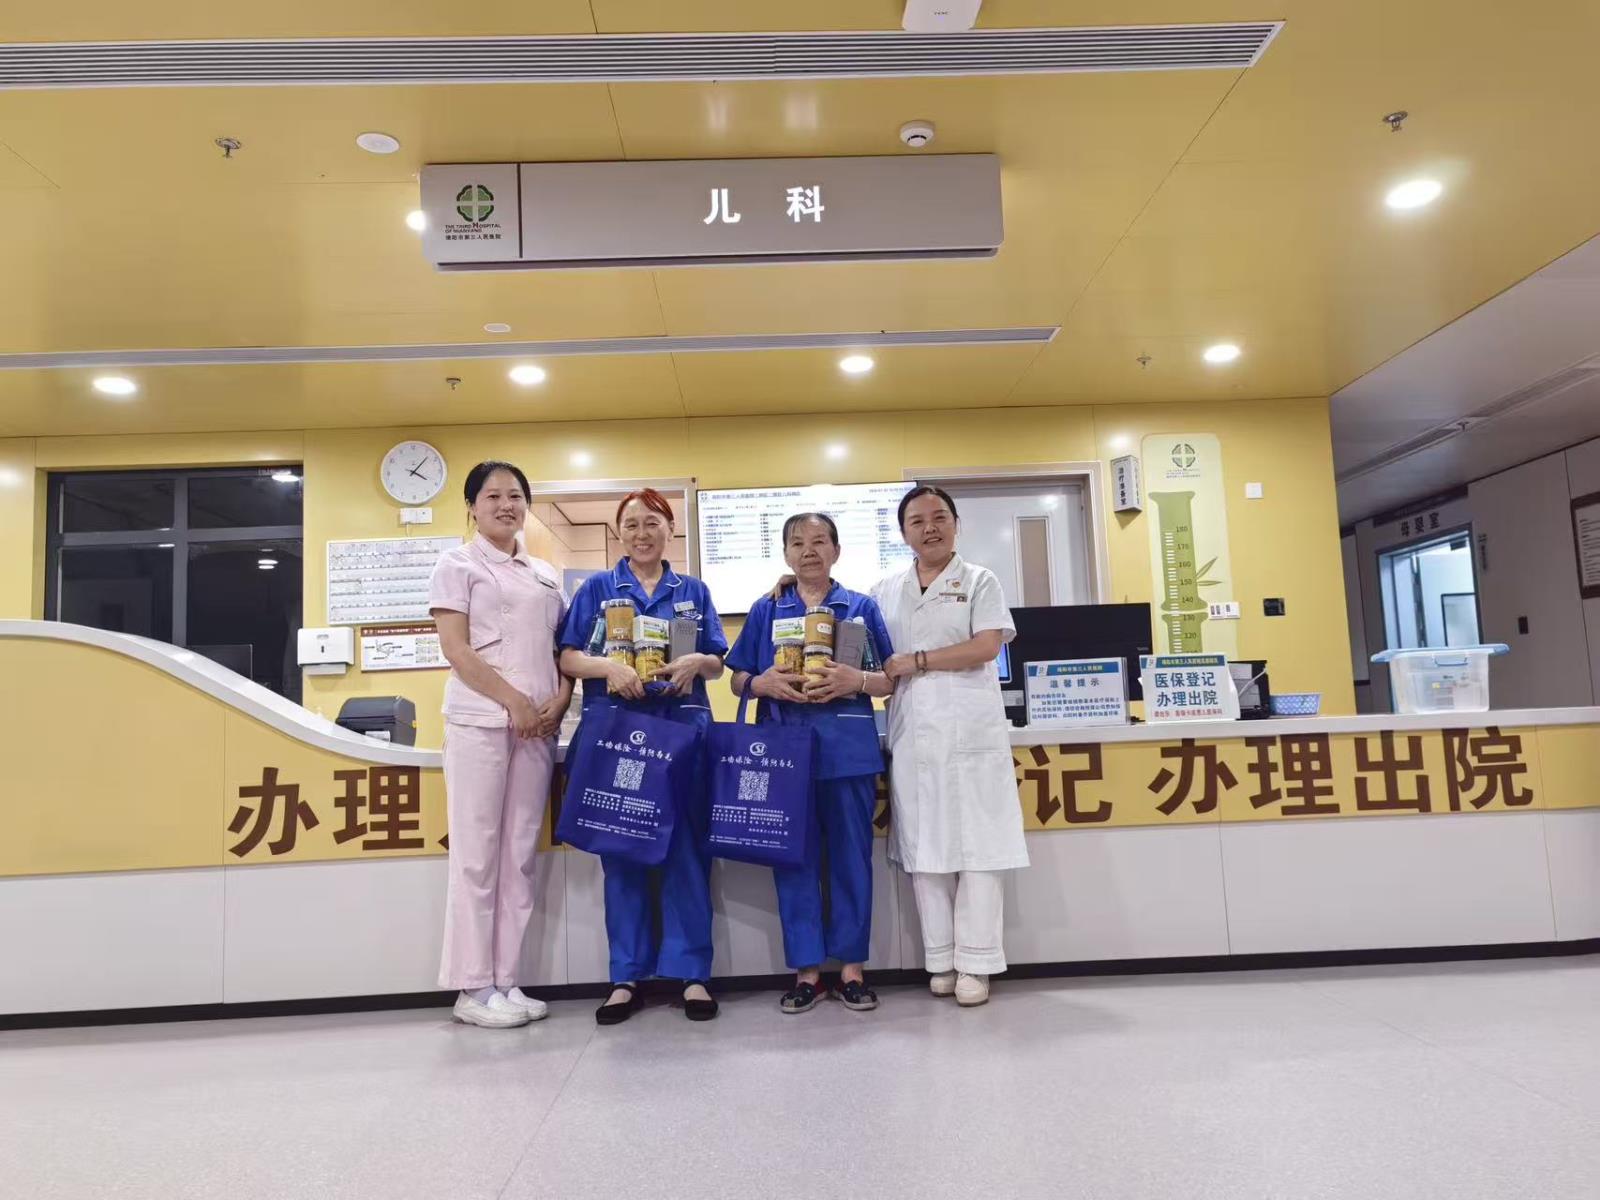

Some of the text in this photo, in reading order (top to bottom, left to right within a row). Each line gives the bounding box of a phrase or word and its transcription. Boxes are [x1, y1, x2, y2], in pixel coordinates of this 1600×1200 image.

[703, 185, 825, 224] 儿科
[1050, 678, 1100, 689] 温馨提示
[1154, 672, 1216, 688] 医保登记
[1157, 690, 1218, 707] 办理出院
[227, 726, 1534, 858] 办理 记 办理出院
